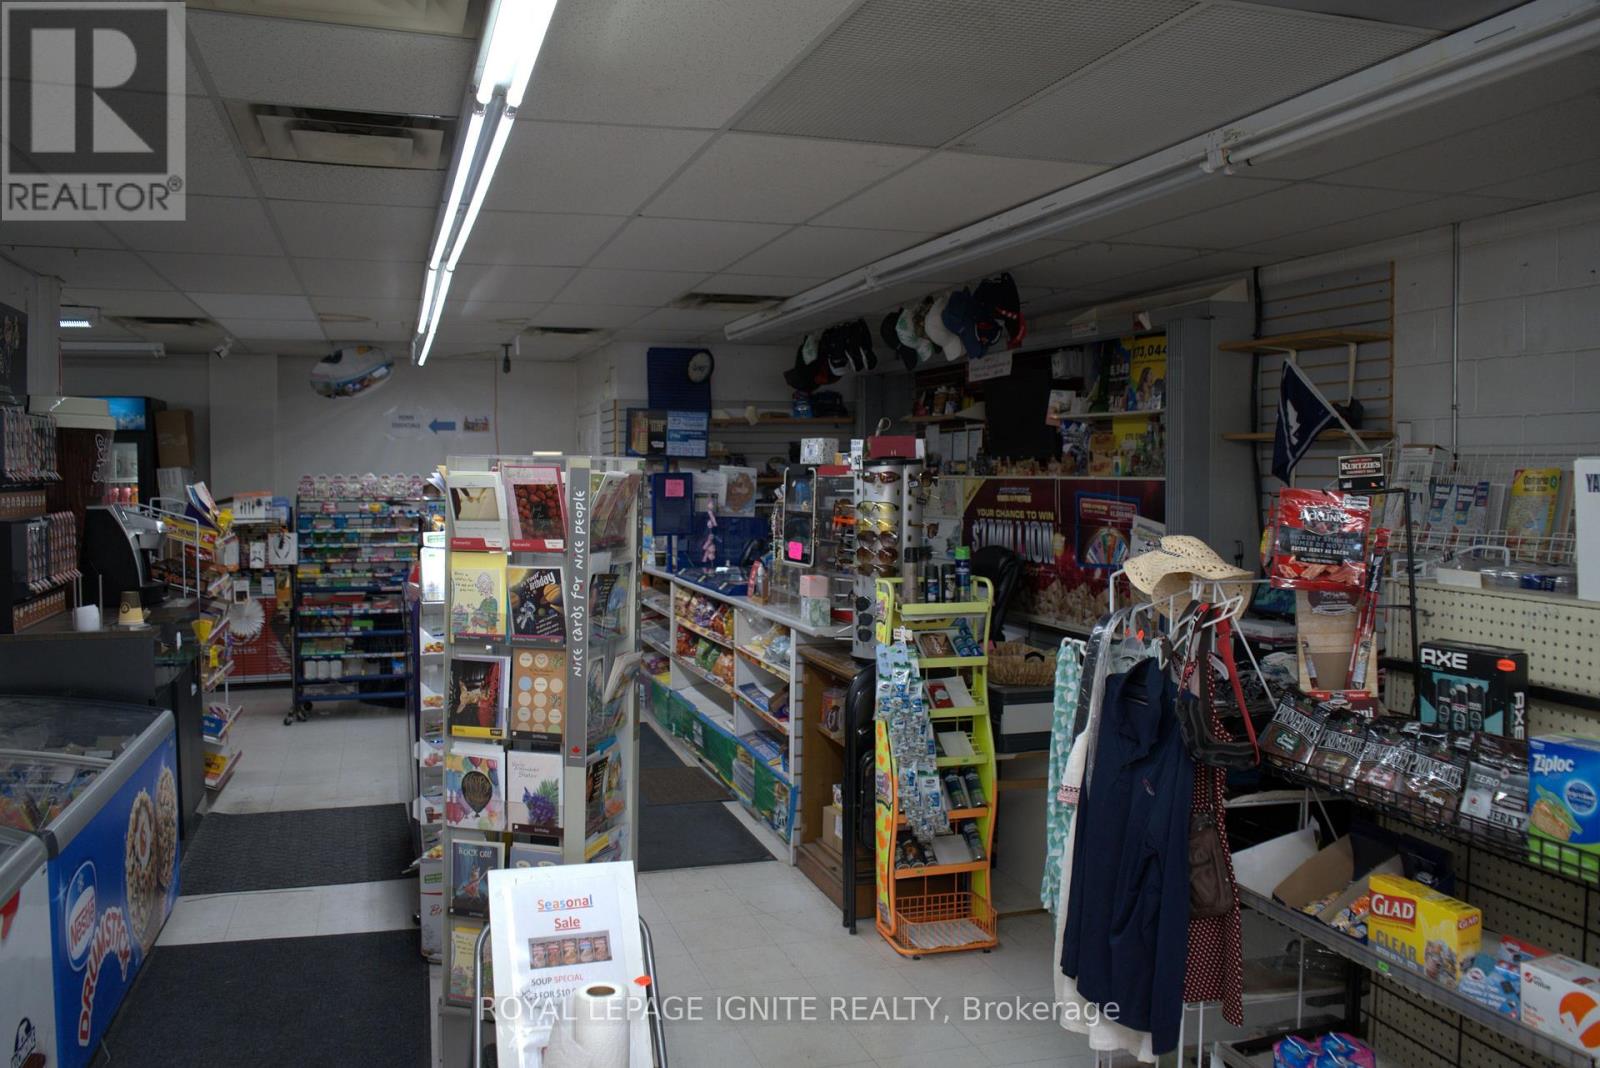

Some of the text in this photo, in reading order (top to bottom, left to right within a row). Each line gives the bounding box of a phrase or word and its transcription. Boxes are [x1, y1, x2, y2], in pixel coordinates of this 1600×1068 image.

[976, 508, 1055, 522] YOUR CHANCE TO WIN
[1420, 647, 1468, 670] AXE
[1513, 691, 1525, 740] AXE
[1532, 753, 1575, 776] Ziploc
[1474, 773, 1500, 787] ZERO
[1488, 810, 1526, 829] JERKY
[537, 894, 594, 912] Seasonal
[1371, 893, 1416, 921] GLAD
[554, 916, 581, 931] Sale
[1458, 915, 1479, 930] GLAD
[1375, 929, 1416, 961] CLEAR
[531, 974, 584, 987] SOUP SPECIAL
[539, 990, 556, 1000] FOR
